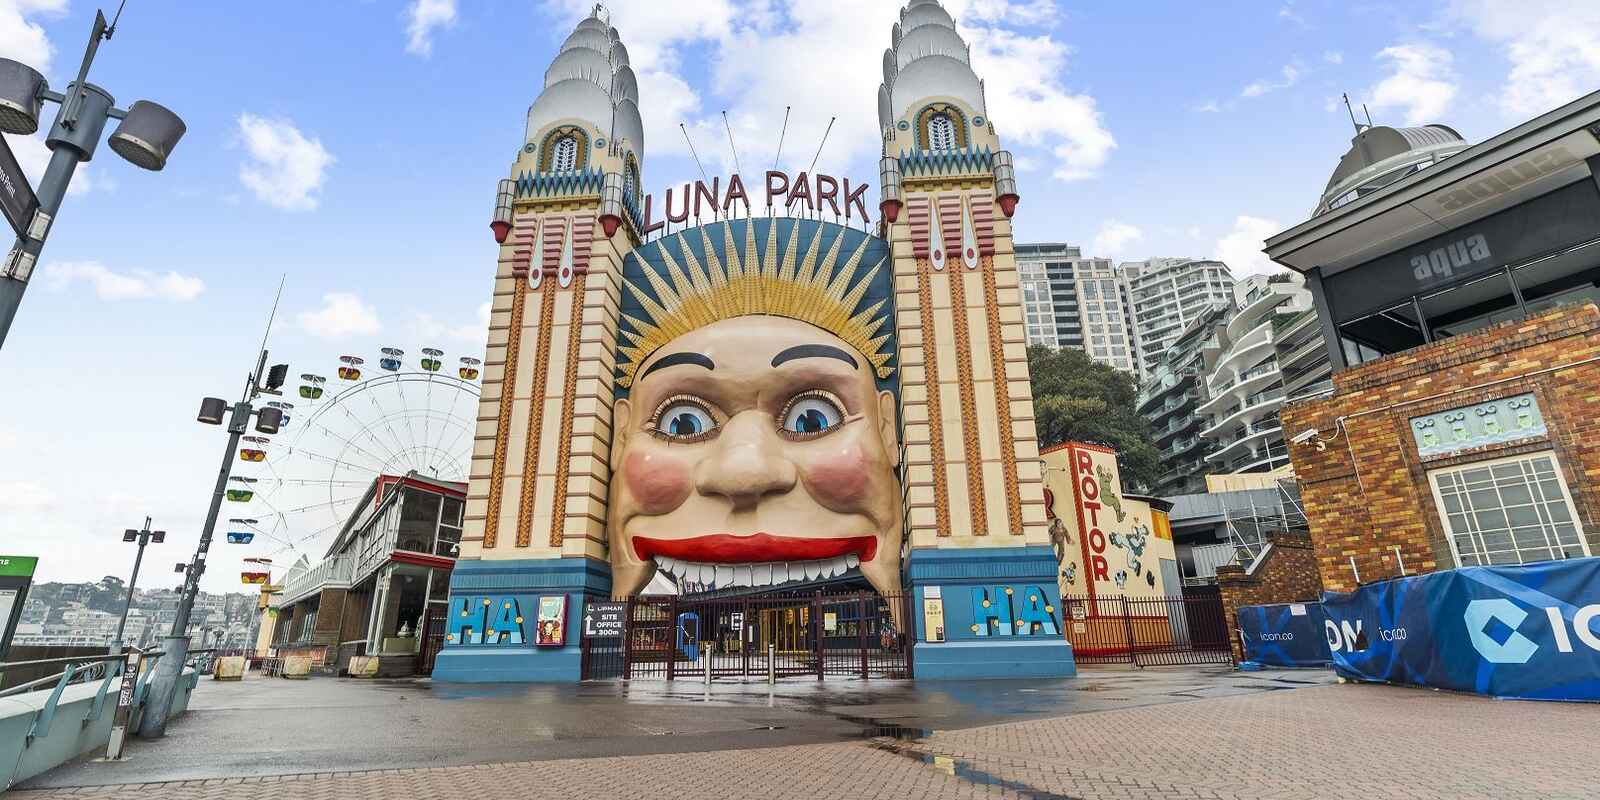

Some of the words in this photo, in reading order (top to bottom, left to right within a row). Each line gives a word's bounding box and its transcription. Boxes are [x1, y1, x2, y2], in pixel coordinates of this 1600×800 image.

[3, 174, 15, 198] Point
[644, 173, 750, 232] LUNA
[765, 170, 869, 223] PARK
[1410, 233, 1491, 280] aqua
[1076, 450, 1110, 581] ROTOR
[447, 597, 526, 645] HA
[596, 621, 622, 629] OFFICE
[601, 613, 618, 621] SITE
[970, 586, 1062, 636] HA
[1259, 632, 1294, 641] icon.co
